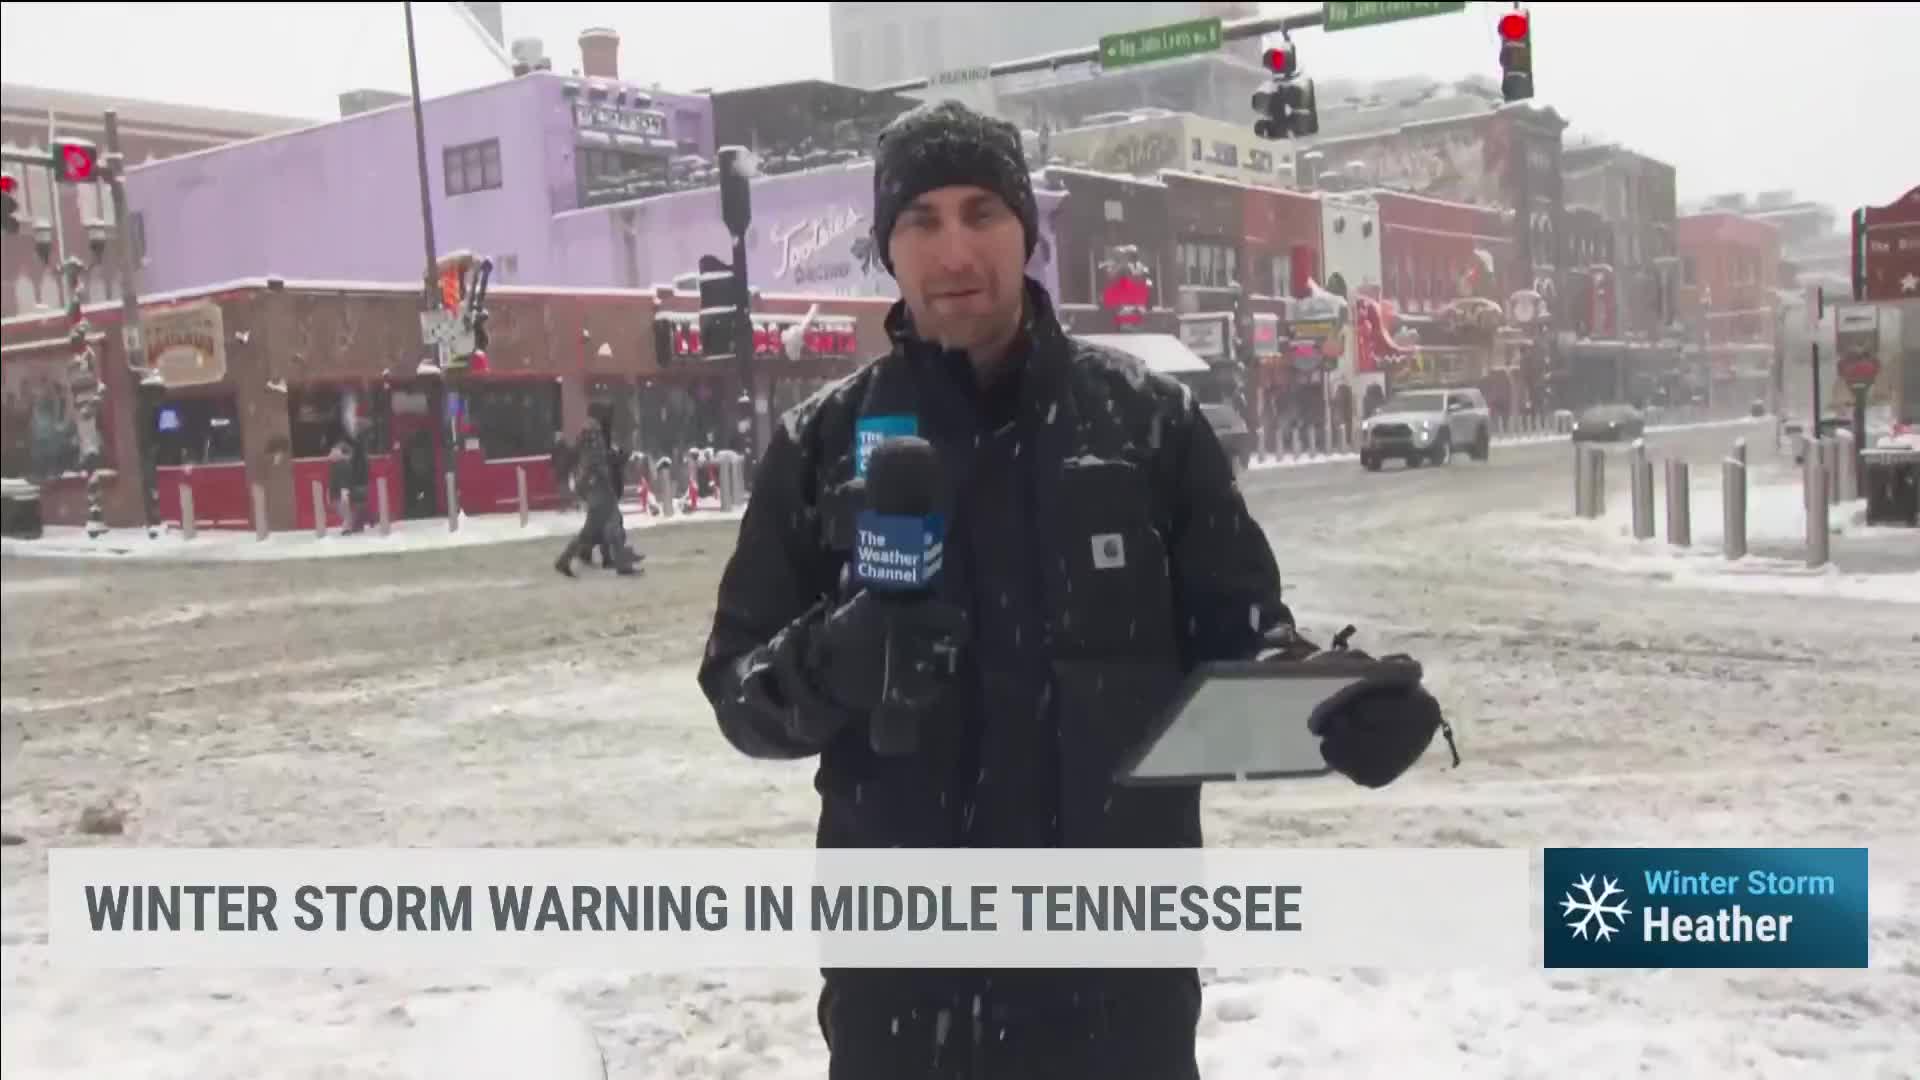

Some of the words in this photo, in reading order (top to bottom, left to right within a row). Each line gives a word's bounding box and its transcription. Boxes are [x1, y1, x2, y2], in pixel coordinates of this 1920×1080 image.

[858, 529, 886, 547] The
[858, 547, 919, 566] Weather
[858, 563, 917, 583] Channel
